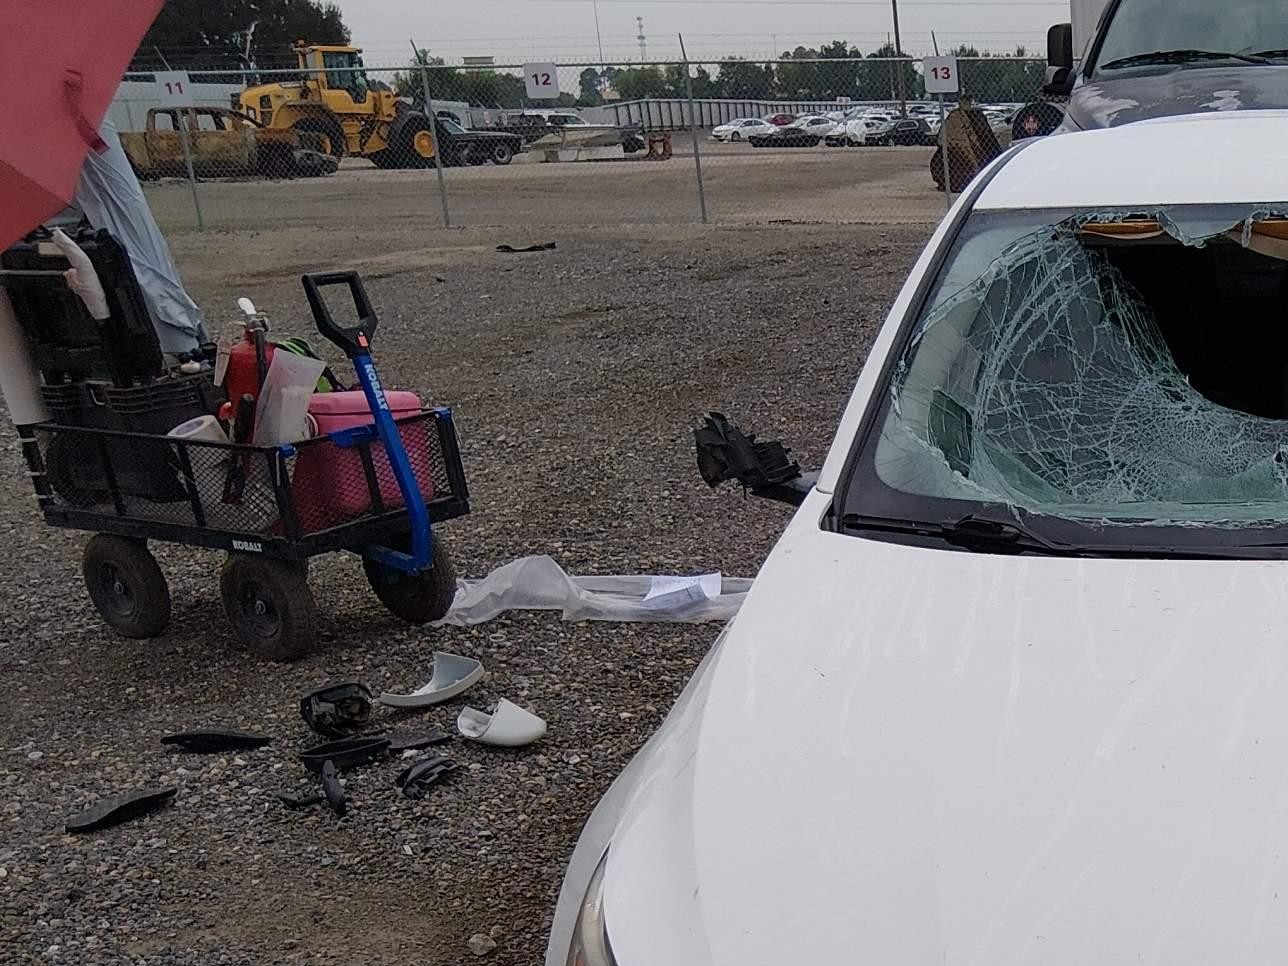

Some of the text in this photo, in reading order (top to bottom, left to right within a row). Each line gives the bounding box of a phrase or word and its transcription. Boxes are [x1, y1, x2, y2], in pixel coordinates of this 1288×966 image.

[531, 72, 552, 86] 12
[930, 66, 951, 80] 13
[164, 81, 184, 95] 11
[364, 363, 389, 410] KOBALT
[231, 539, 263, 553] KOBALT
